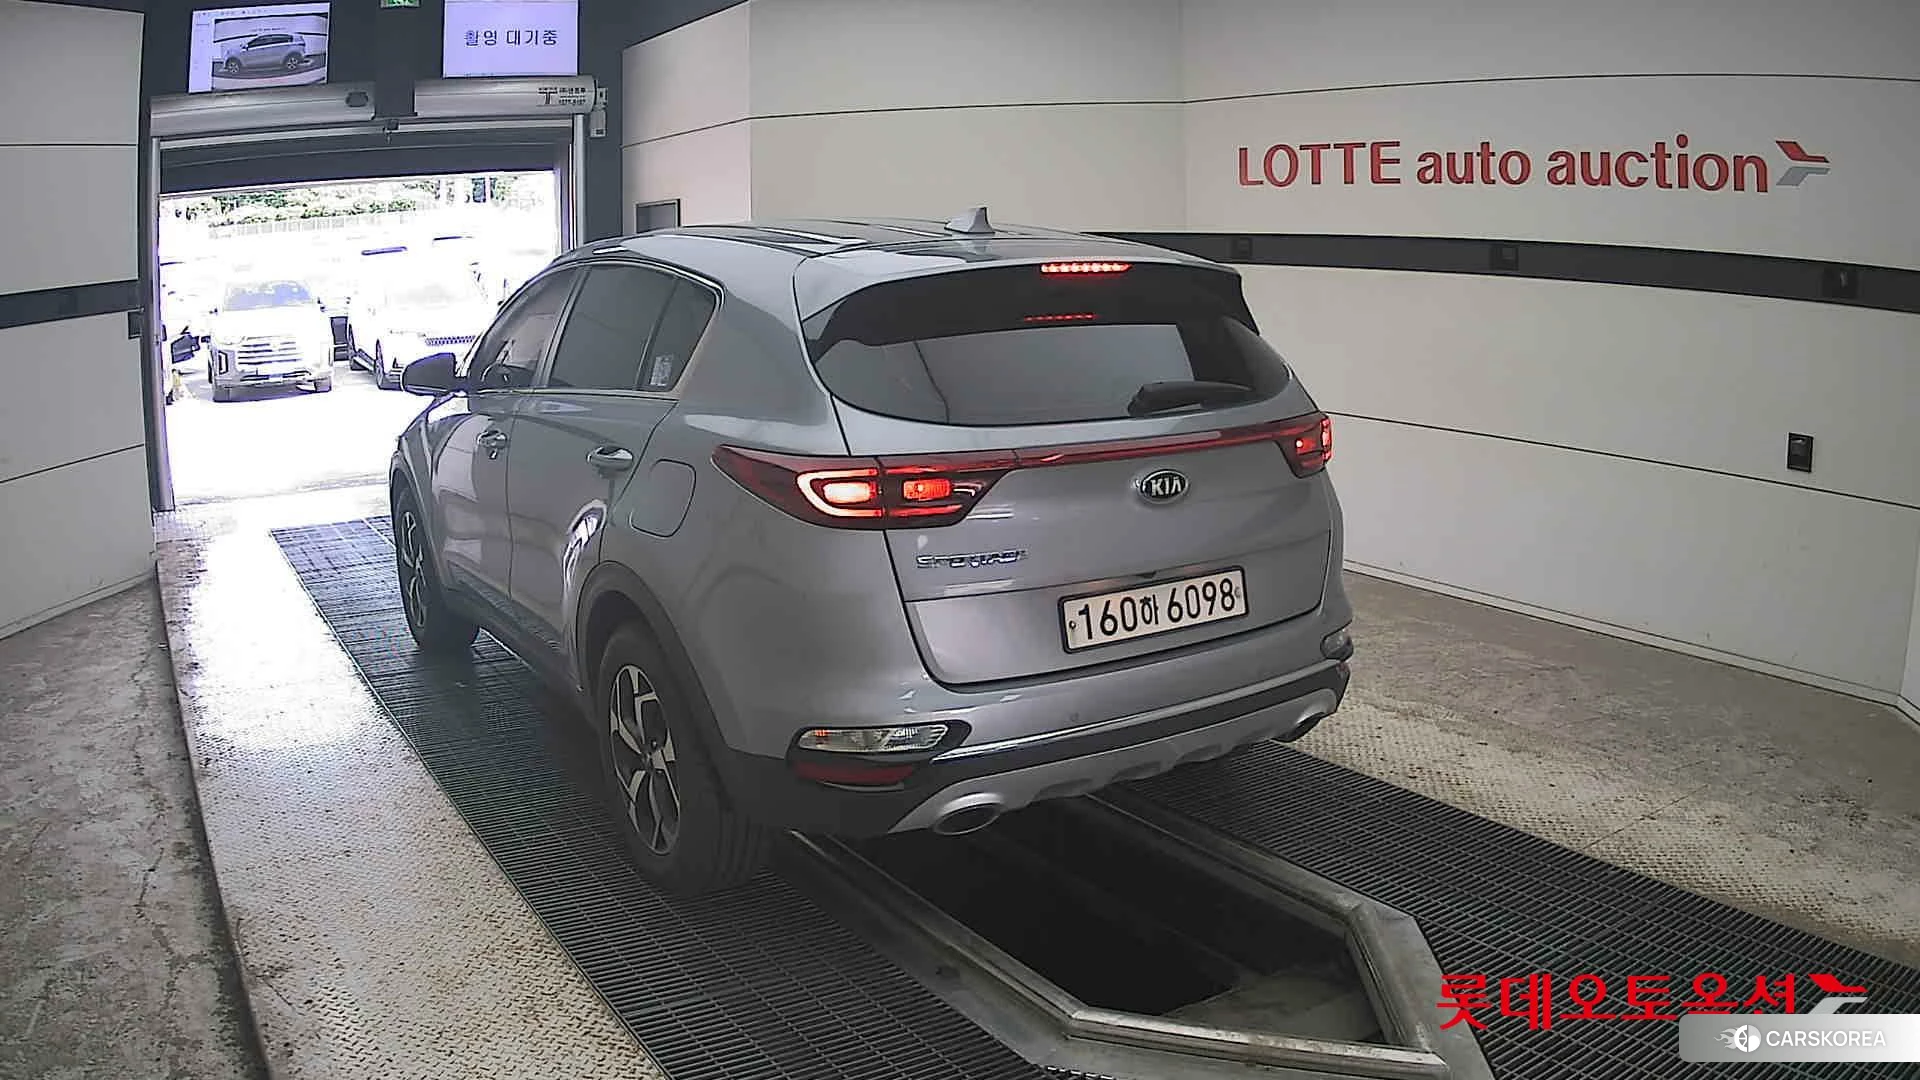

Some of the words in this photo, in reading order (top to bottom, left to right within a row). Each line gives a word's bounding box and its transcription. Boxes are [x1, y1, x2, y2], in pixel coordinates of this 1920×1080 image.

[506, 29, 558, 46] 대기중
[1237, 141, 1401, 187] LOTTE
[1416, 141, 1532, 186] auto
[1546, 134, 1769, 193] auction
[1150, 475, 1182, 497] KIA
[1078, 594, 1160, 641] 160하
[1166, 577, 1236, 624] 6098
